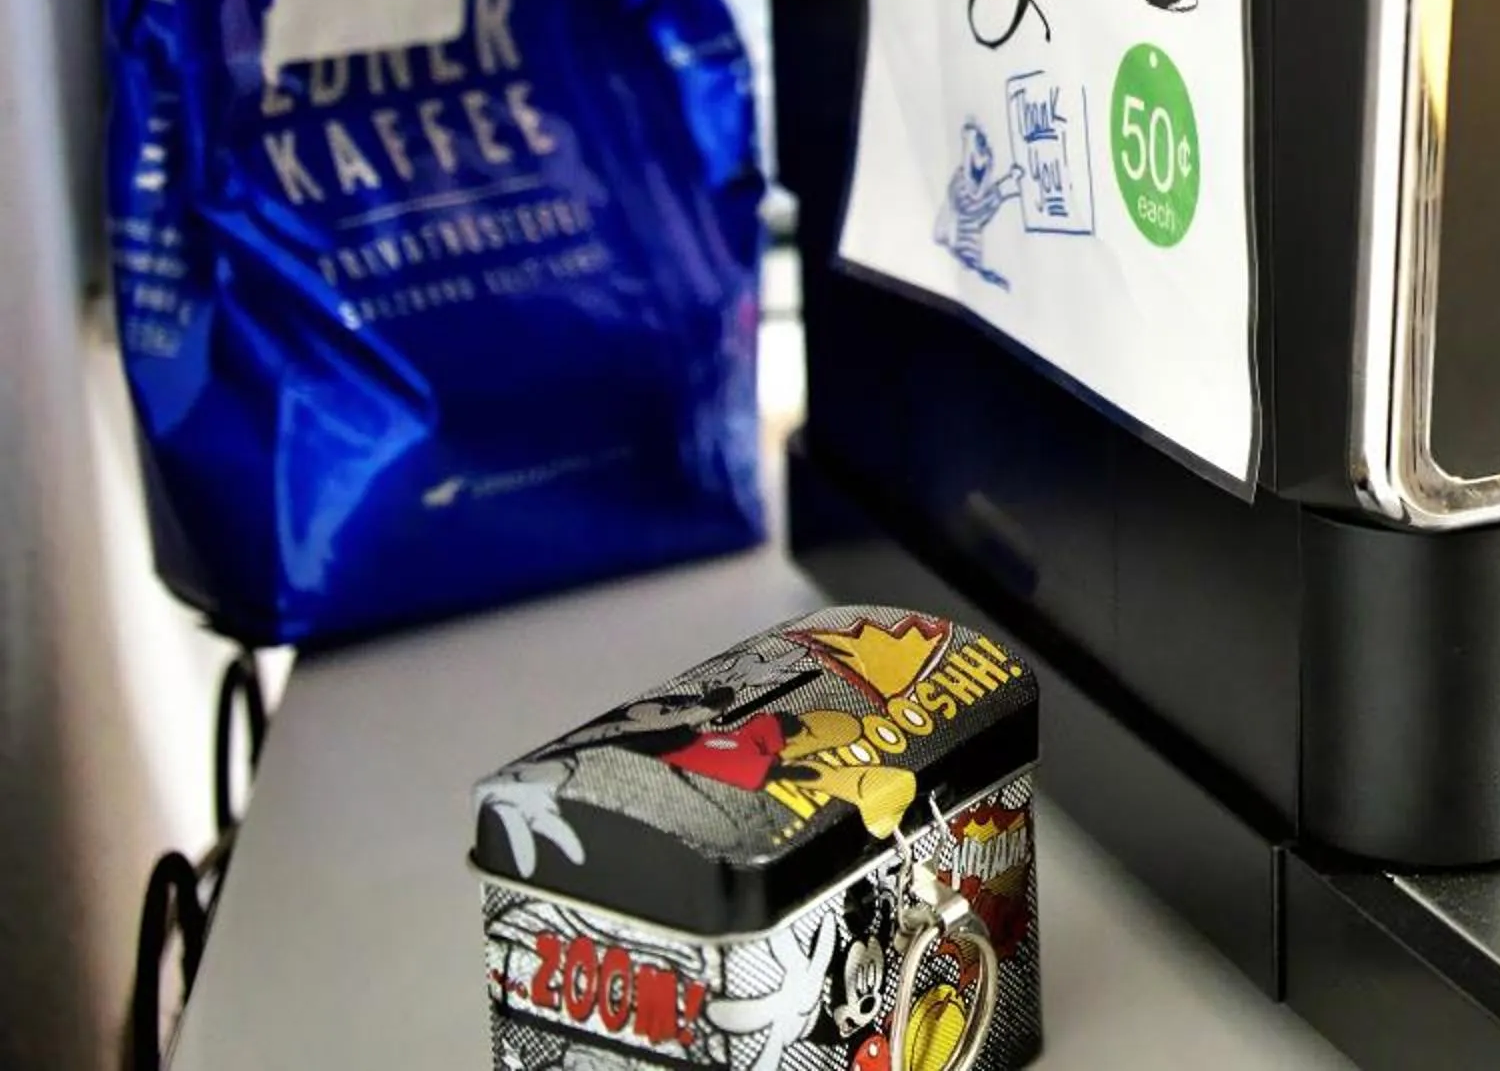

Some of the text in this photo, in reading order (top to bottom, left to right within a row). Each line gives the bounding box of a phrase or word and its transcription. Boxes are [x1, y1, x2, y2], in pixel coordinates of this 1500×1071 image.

[262, 83, 556, 205] KAFFEE
[1010, 86, 1067, 141] Thank
[1121, 94, 1192, 193] 50¢
[1137, 194, 1175, 233] each
